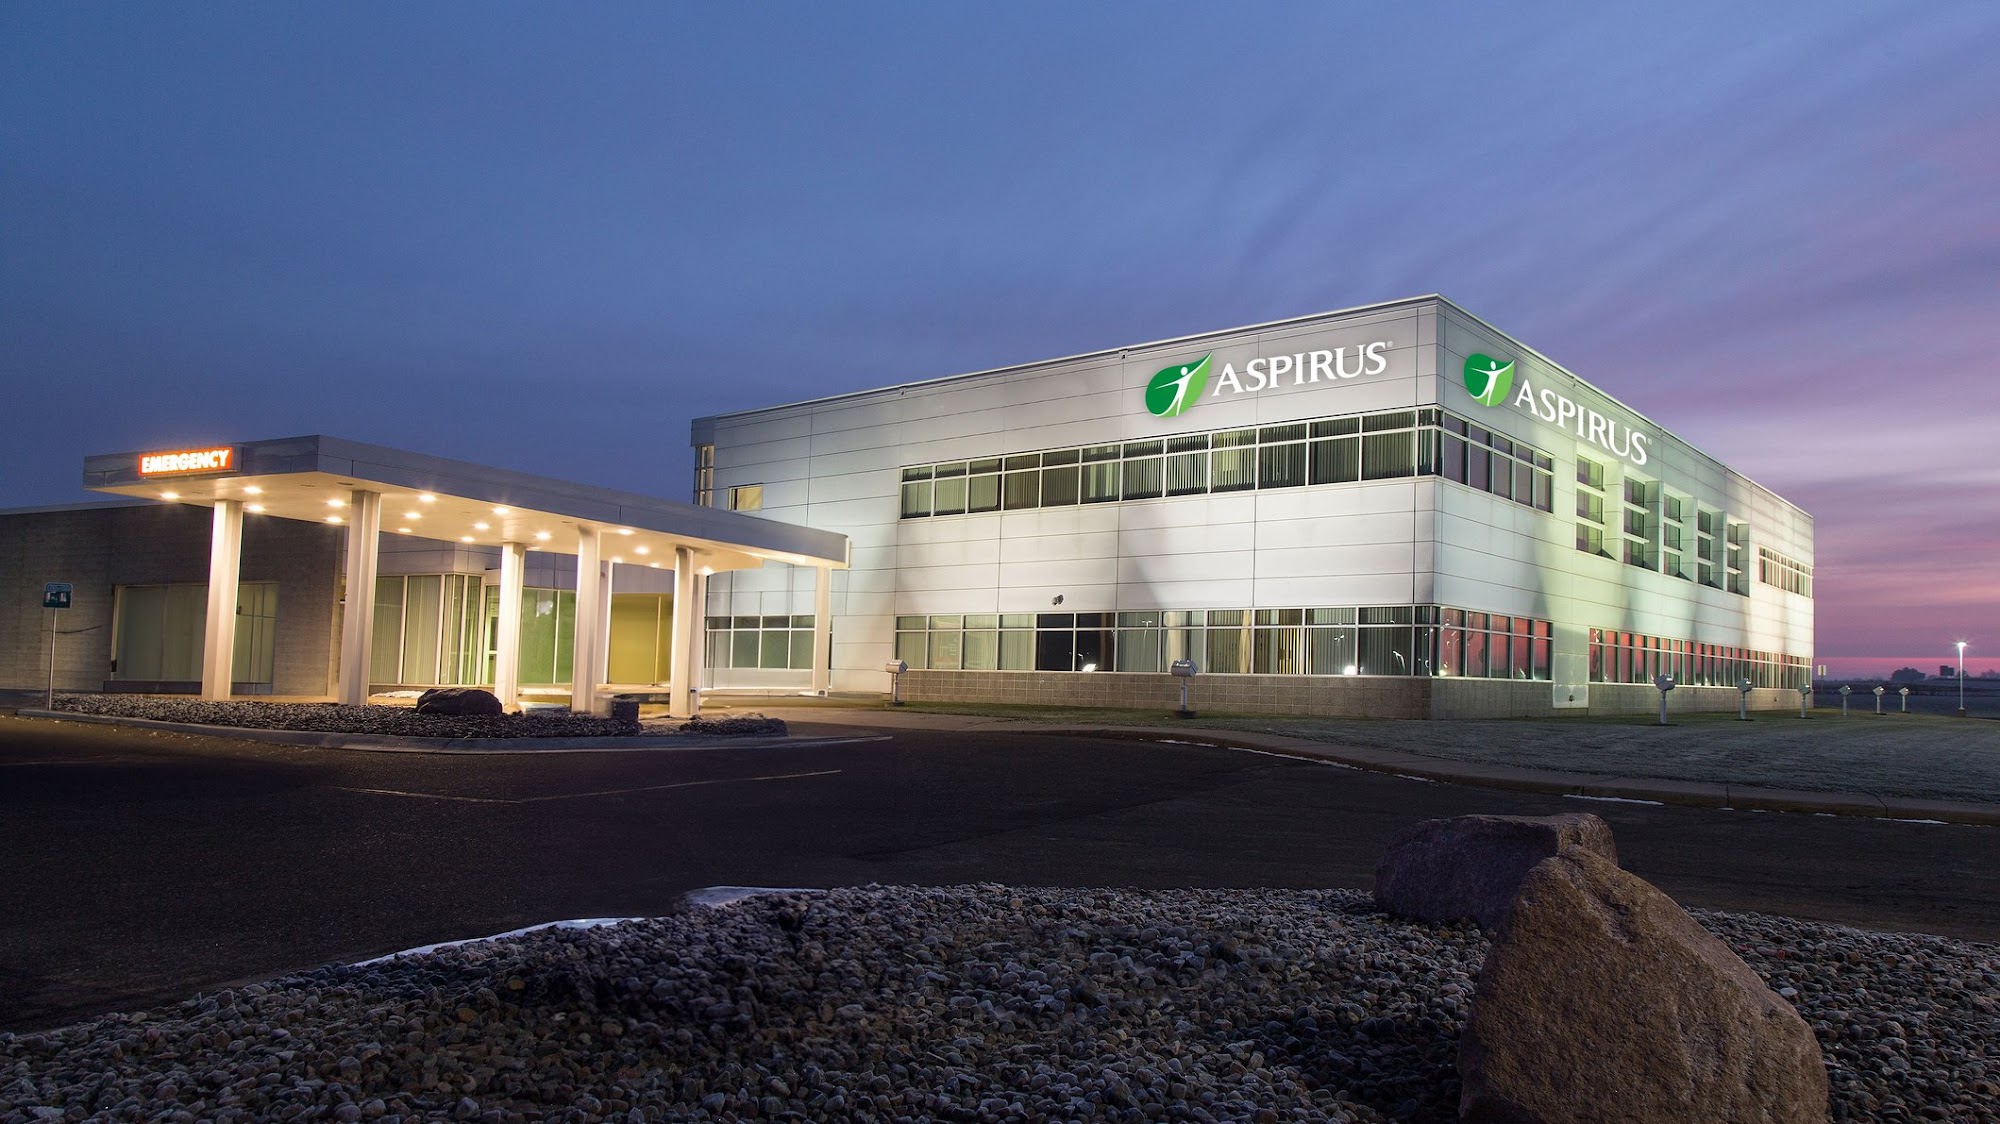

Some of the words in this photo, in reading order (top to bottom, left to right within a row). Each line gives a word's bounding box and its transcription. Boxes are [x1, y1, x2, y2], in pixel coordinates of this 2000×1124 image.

[1211, 341, 1388, 397] ASPIRUS
[1514, 379, 1648, 465] ASPIRUS
[141, 449, 230, 474] EMERGENCY
